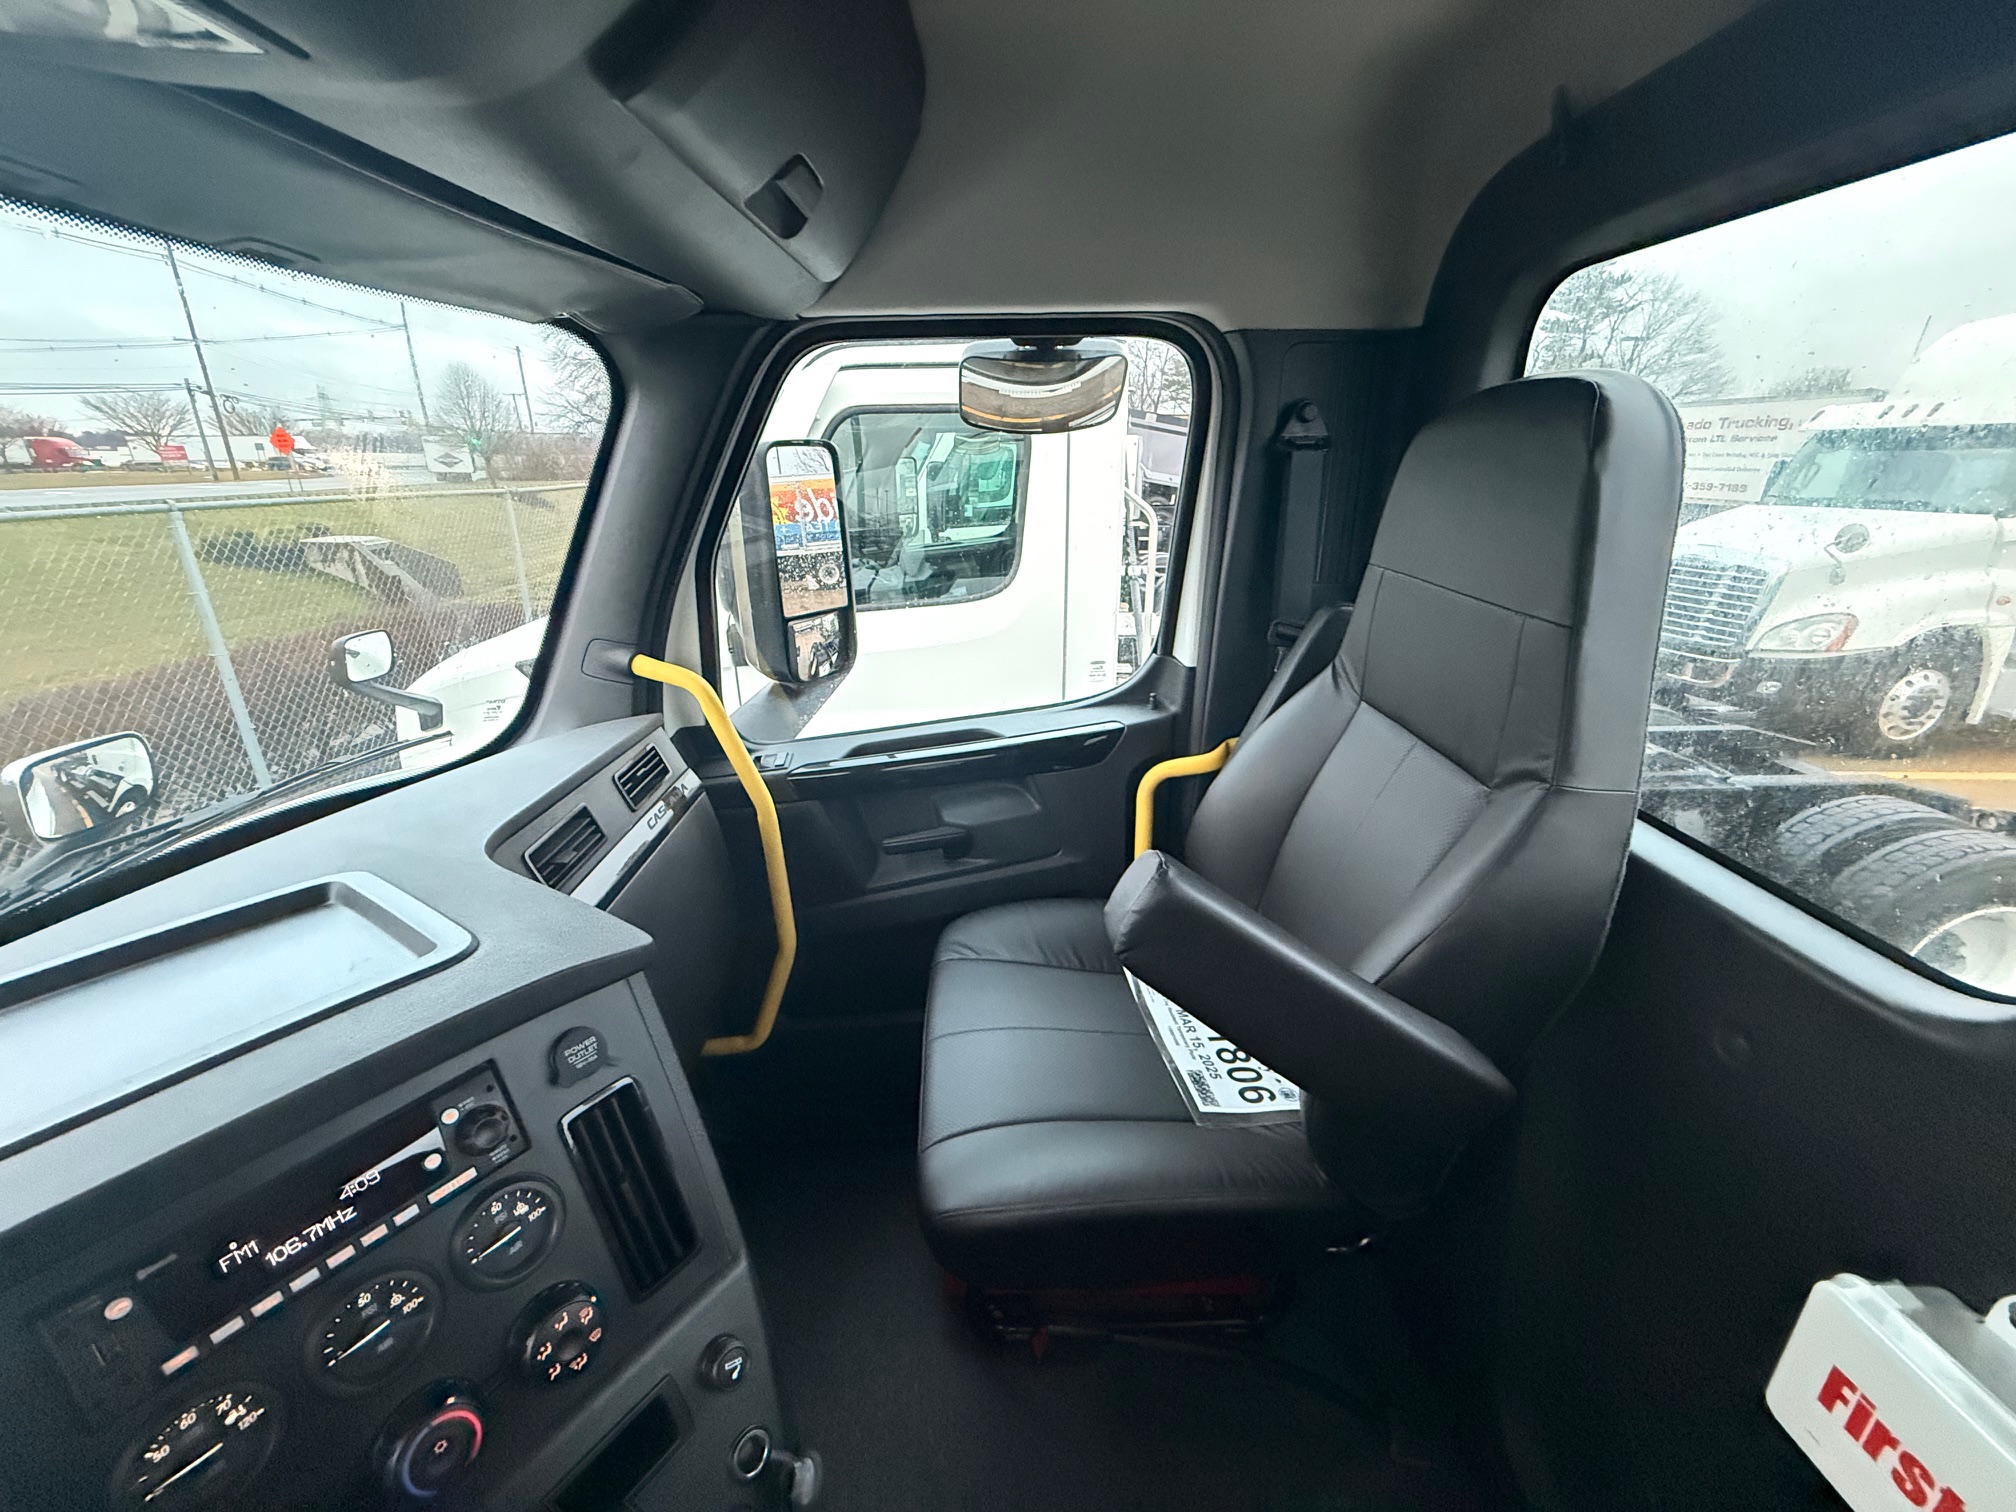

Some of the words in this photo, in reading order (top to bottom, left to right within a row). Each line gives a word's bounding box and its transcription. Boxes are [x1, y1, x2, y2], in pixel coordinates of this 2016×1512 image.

[1719, 415, 1794, 431] Trucking,
[1710, 434, 1726, 443] LTL
[563, 1035, 597, 1057] POWER
[567, 1042, 598, 1064] OUTLET
[1175, 1009, 1197, 1033] MAR
[1190, 1035, 1206, 1051] 15,
[1198, 1053, 1223, 1080] 2025
[339, 1169, 381, 1200] 4:09
[491, 1202, 502, 1215] 50
[528, 1208, 541, 1222] 100
[265, 1206, 357, 1266] 106.7MHz
[218, 1240, 260, 1273] FM1
[358, 1293, 371, 1307] 50
[402, 1298, 418, 1314] 100
[215, 1399, 231, 1416] 70
[179, 1412, 196, 1430] 60
[238, 1411, 257, 1430] 120
[153, 1444, 170, 1463] 50
